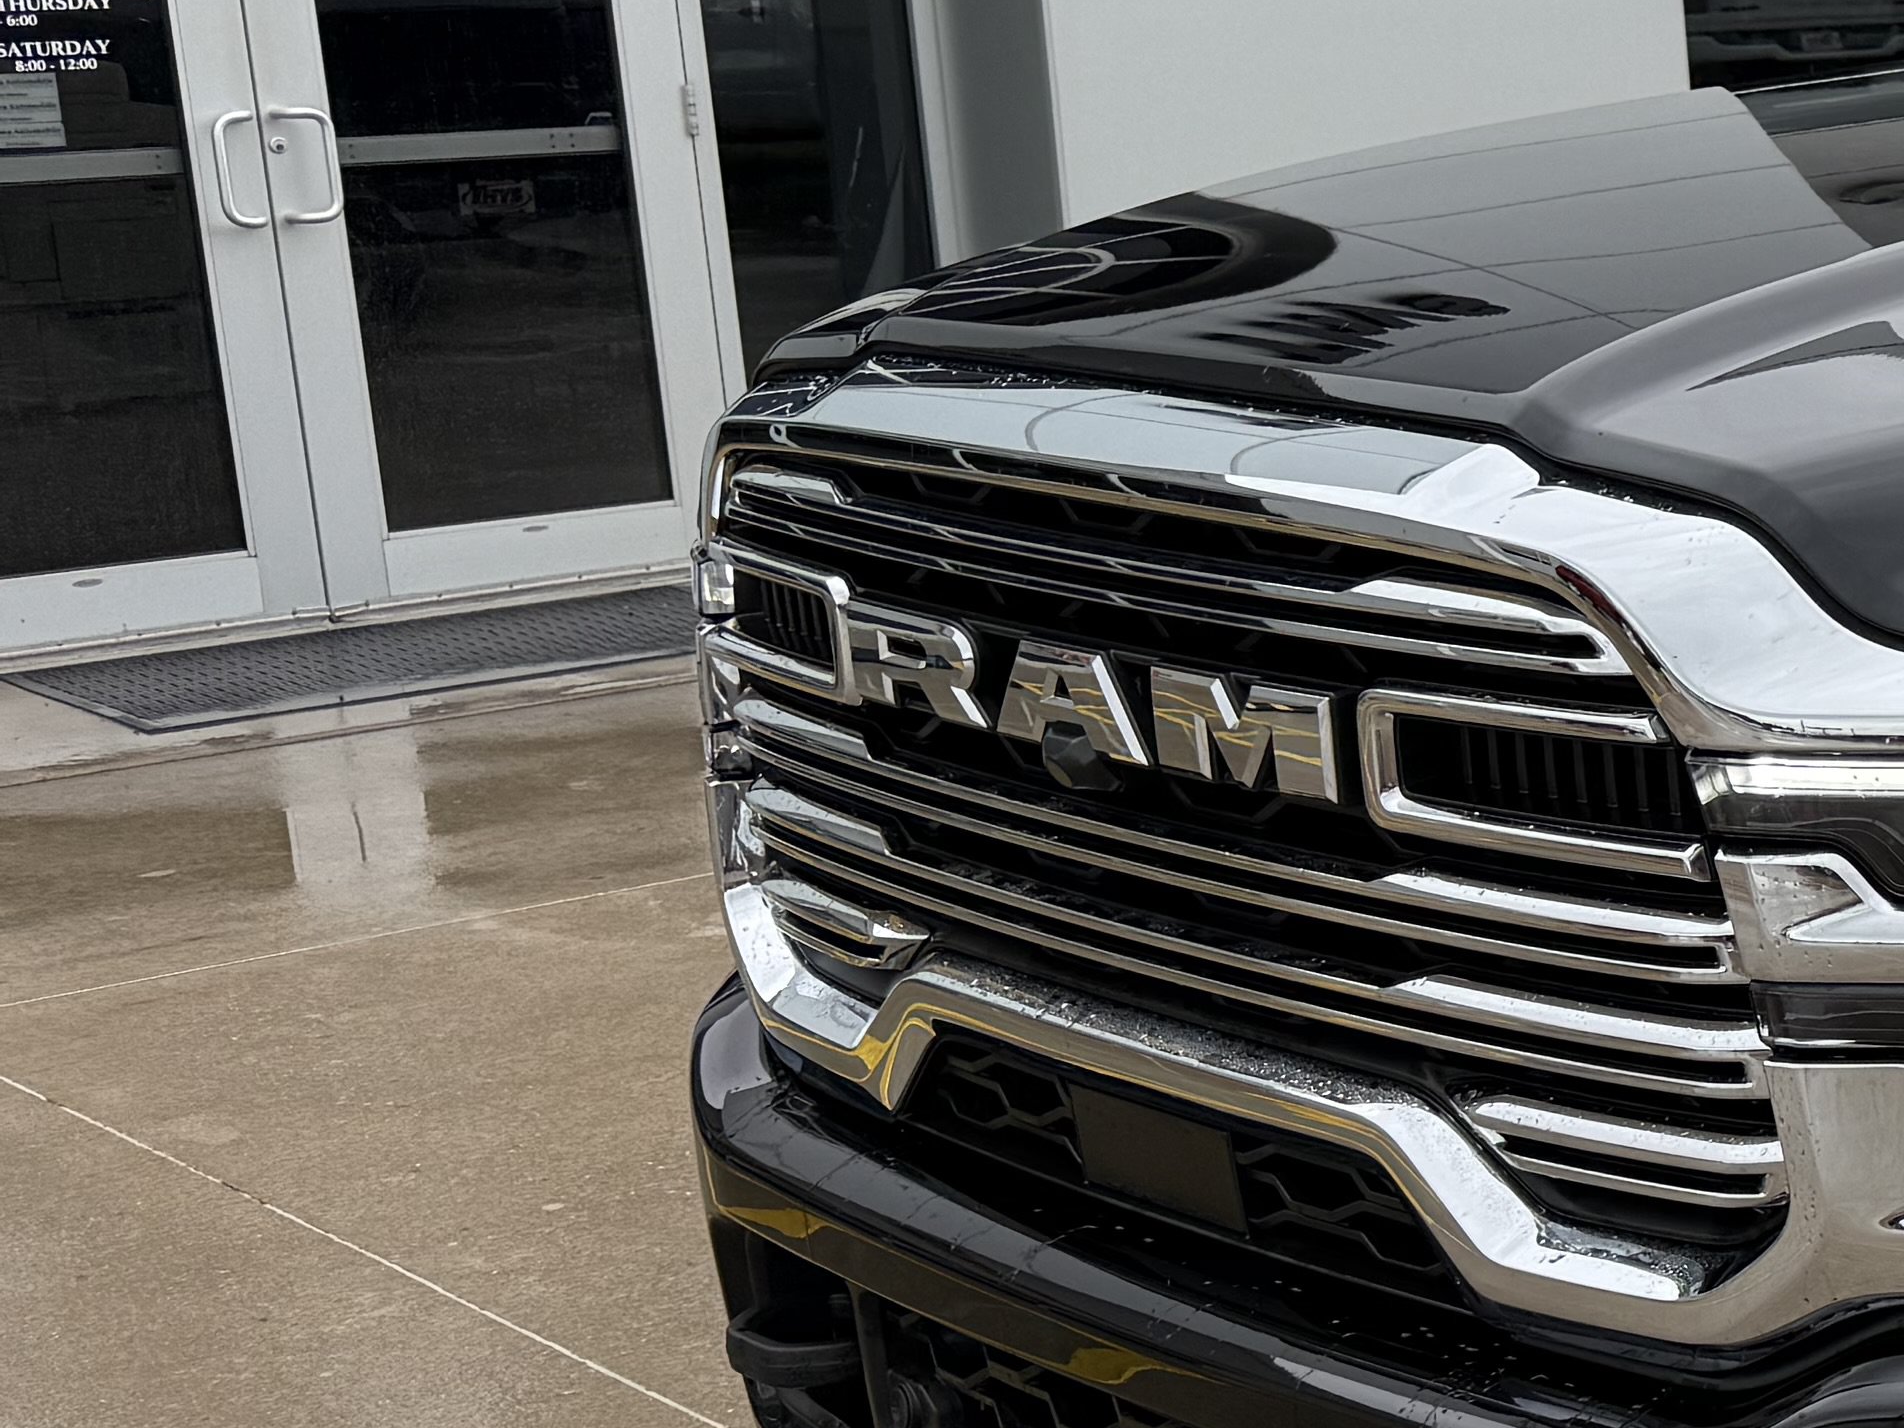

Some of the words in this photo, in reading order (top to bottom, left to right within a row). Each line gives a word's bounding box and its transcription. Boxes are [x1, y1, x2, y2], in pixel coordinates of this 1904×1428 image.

[6, 14, 38, 27] 6:00
[15, 59, 47, 72] 8:00
[60, 58, 98, 70] 12:00
[850, 600, 1341, 805] RAM
